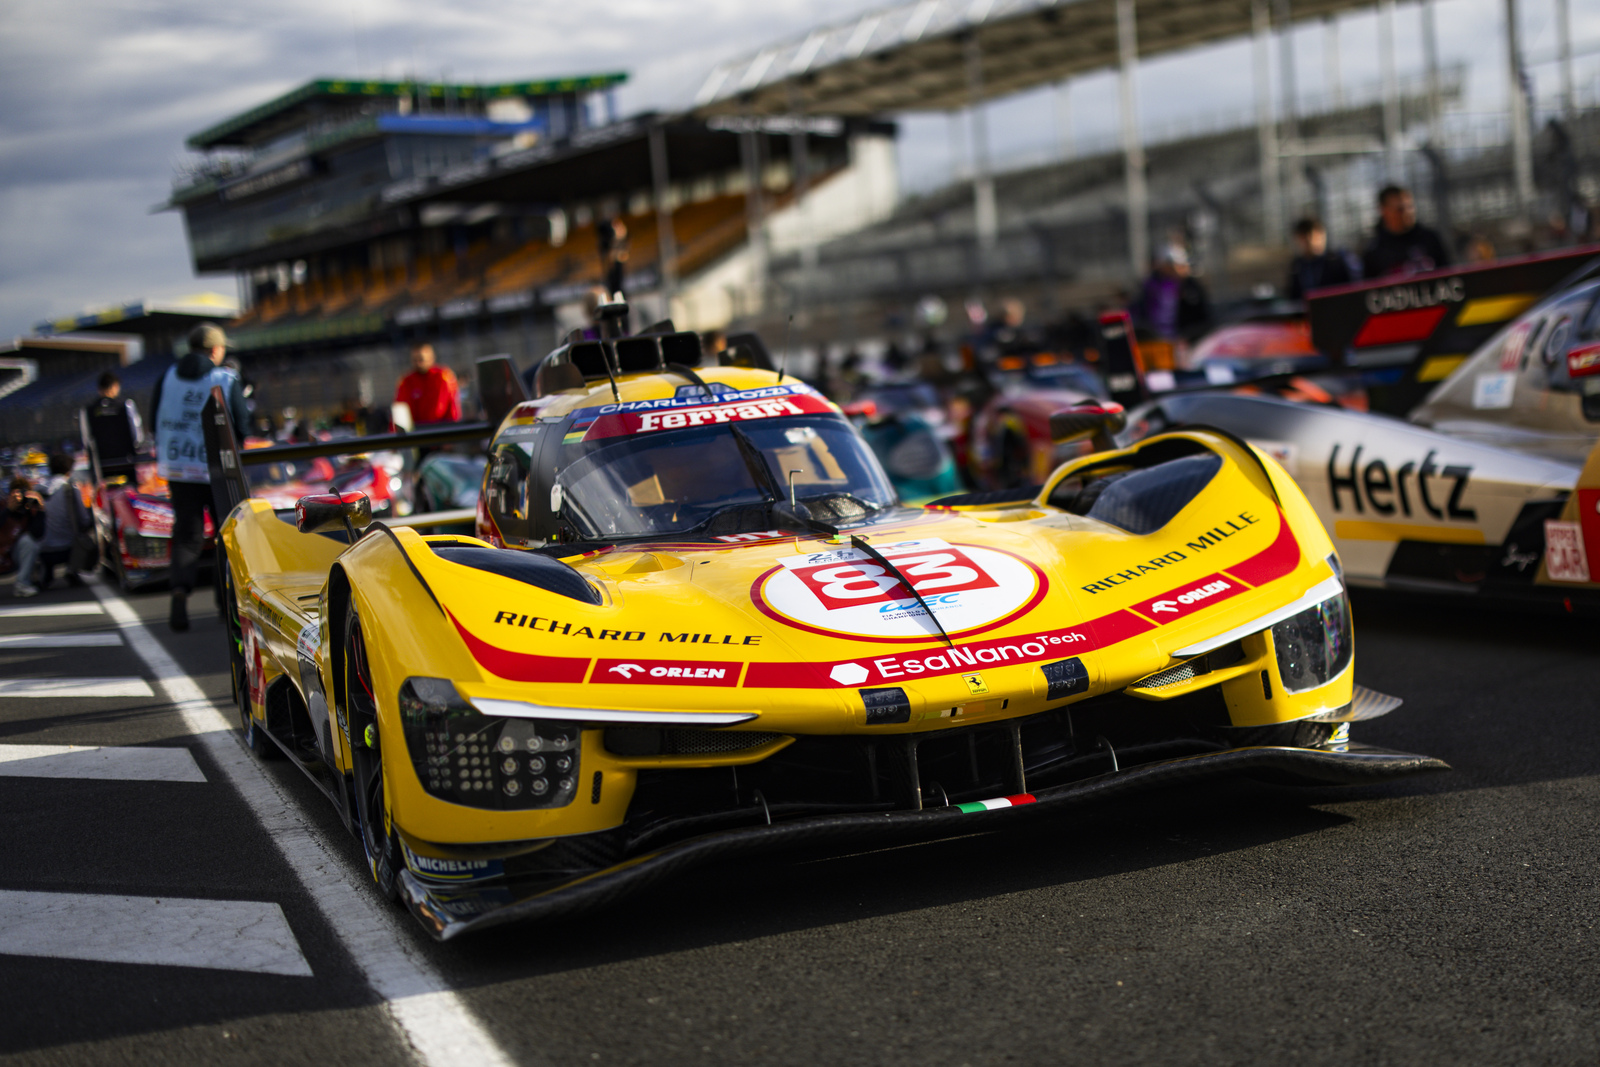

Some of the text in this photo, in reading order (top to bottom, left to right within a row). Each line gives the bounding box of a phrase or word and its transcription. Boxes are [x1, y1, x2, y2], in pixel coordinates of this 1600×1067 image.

[1365, 277, 1466, 314] CADILLAC
[722, 386, 789, 402] POZZI
[636, 398, 804, 433] Ferrari
[1328, 445, 1478, 521] Hertz
[1081, 511, 1260, 594] RICHARD MILLE
[812, 553, 979, 599] 83
[879, 593, 960, 613] WEC
[1177, 580, 1231, 605] ORLEN
[494, 611, 762, 646] RICHARD MILLE
[883, 610, 937, 621] CHAMPIONSHP
[650, 666, 726, 679] ORLEN
[418, 856, 488, 872] MICHELIN
